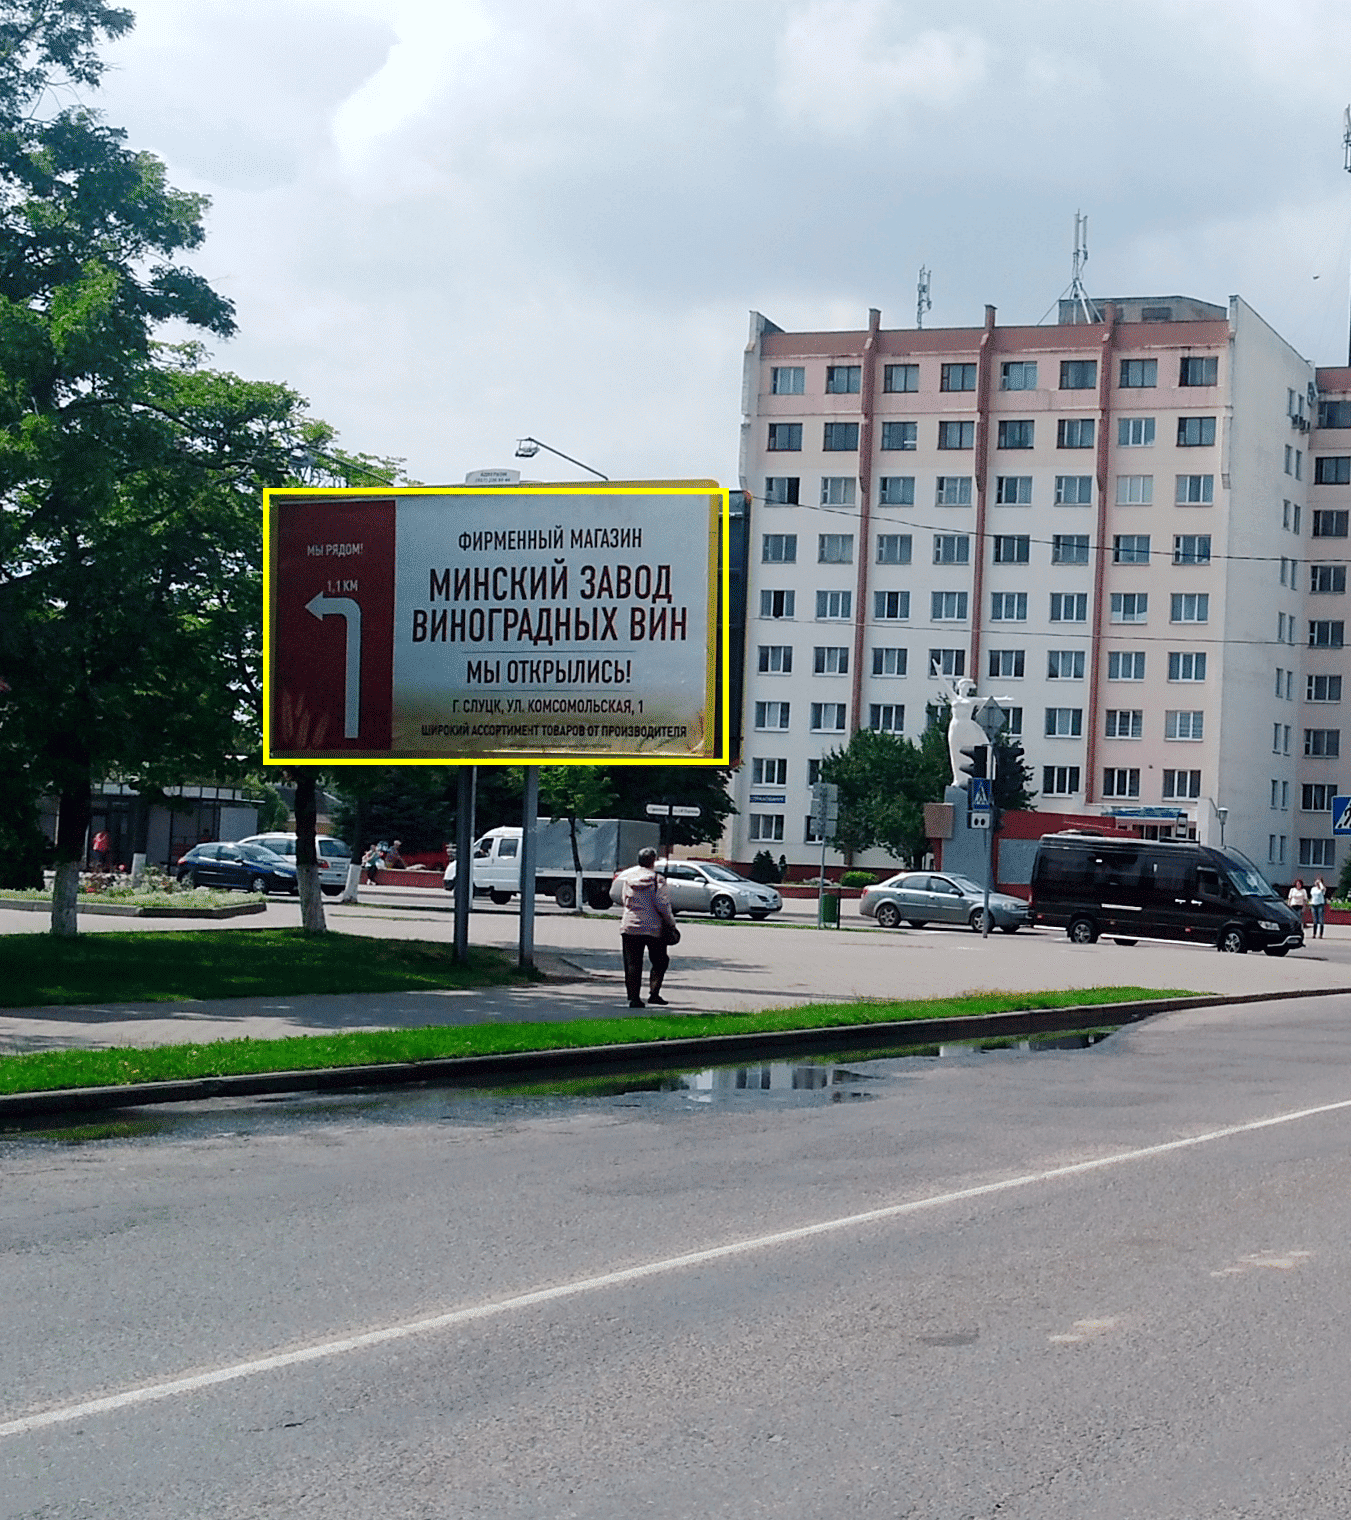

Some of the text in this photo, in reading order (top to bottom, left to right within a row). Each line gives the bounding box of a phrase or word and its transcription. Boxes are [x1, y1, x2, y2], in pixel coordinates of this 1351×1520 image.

[458, 525, 642, 551] ФИРМЕННЫЙ МАГАЗИН
[307, 543, 364, 557] МЫ РЯДОМ!
[327, 580, 358, 593] 1,1 КМ
[429, 558, 673, 604] МИНСКИЙ ЗАВОД
[411, 606, 687, 647] ВИНОГРАДНЫХ ВИН
[467, 659, 631, 684] МЫ ОТКРЫЛИСЬ!
[452, 699, 643, 716] Г. СЛУЦК, УЛ. КОМСОМОЛЬСКАЯ, 1
[421, 722, 687, 739] ШИРОКИЙ АССОРТИМЕНТ ТОВАРОВ ОТ ПРОИЗВОДИТЕЛЯ
